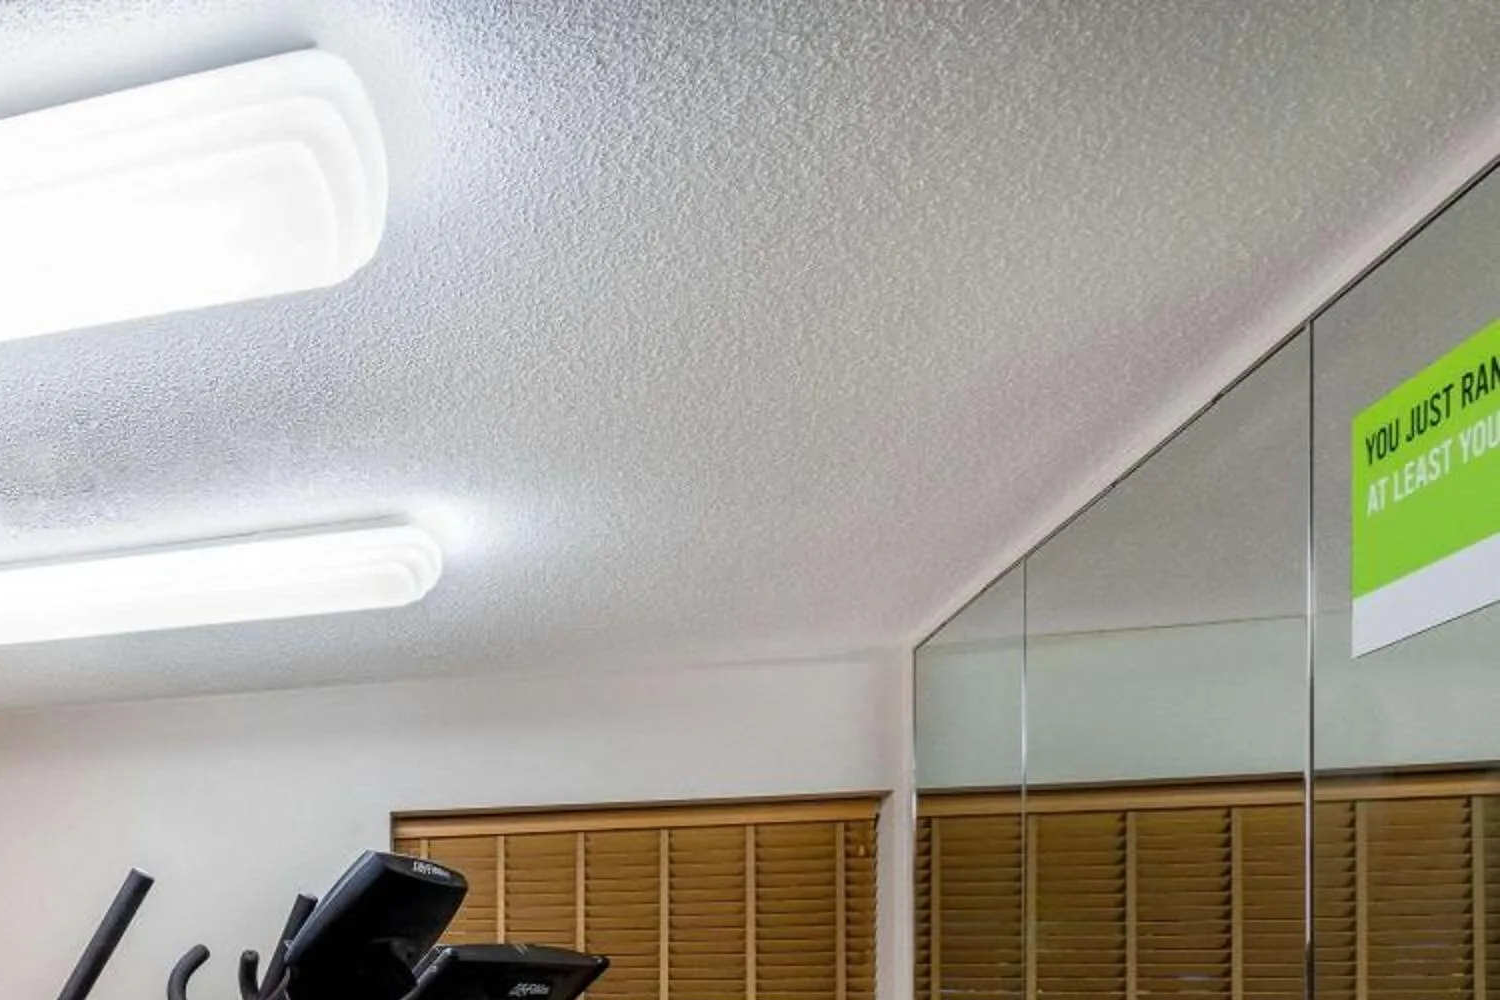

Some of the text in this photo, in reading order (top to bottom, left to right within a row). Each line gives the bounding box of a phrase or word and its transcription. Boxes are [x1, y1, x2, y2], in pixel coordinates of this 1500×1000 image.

[1365, 417, 1400, 466] YOU
[1405, 383, 1454, 443] JUST
[1367, 409, 1500, 517] AT LEAST YOU
